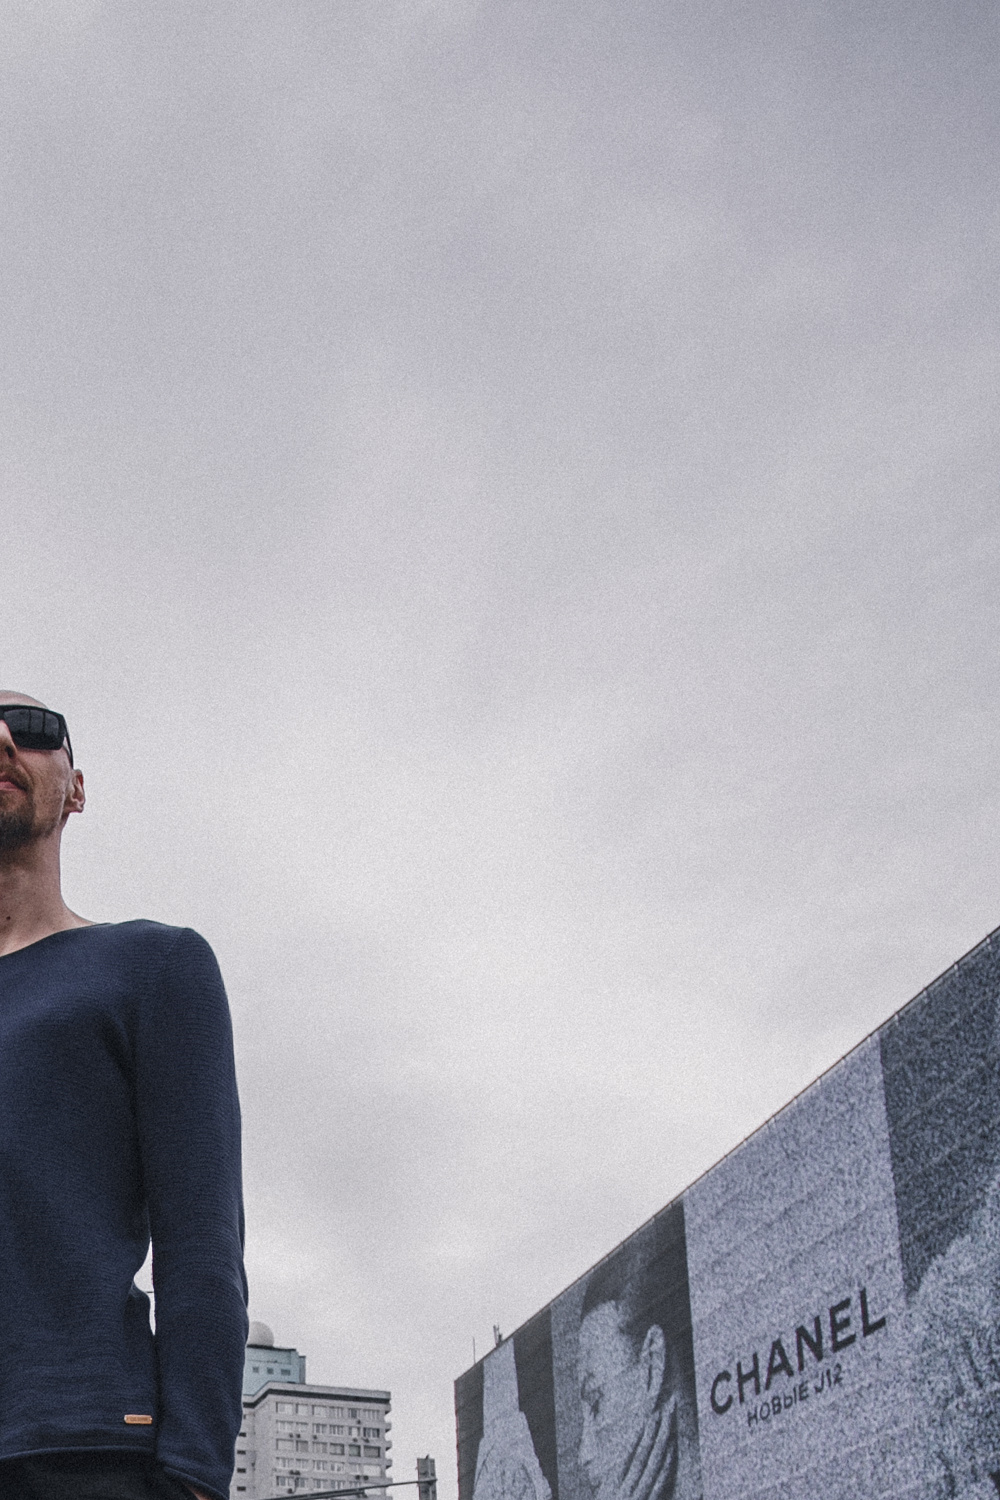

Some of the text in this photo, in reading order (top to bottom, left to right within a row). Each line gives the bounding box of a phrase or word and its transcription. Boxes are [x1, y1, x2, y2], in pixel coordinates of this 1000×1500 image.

[709, 1287, 886, 1414] CHANEL
[748, 1363, 843, 1427] НОВЫЕ J12
